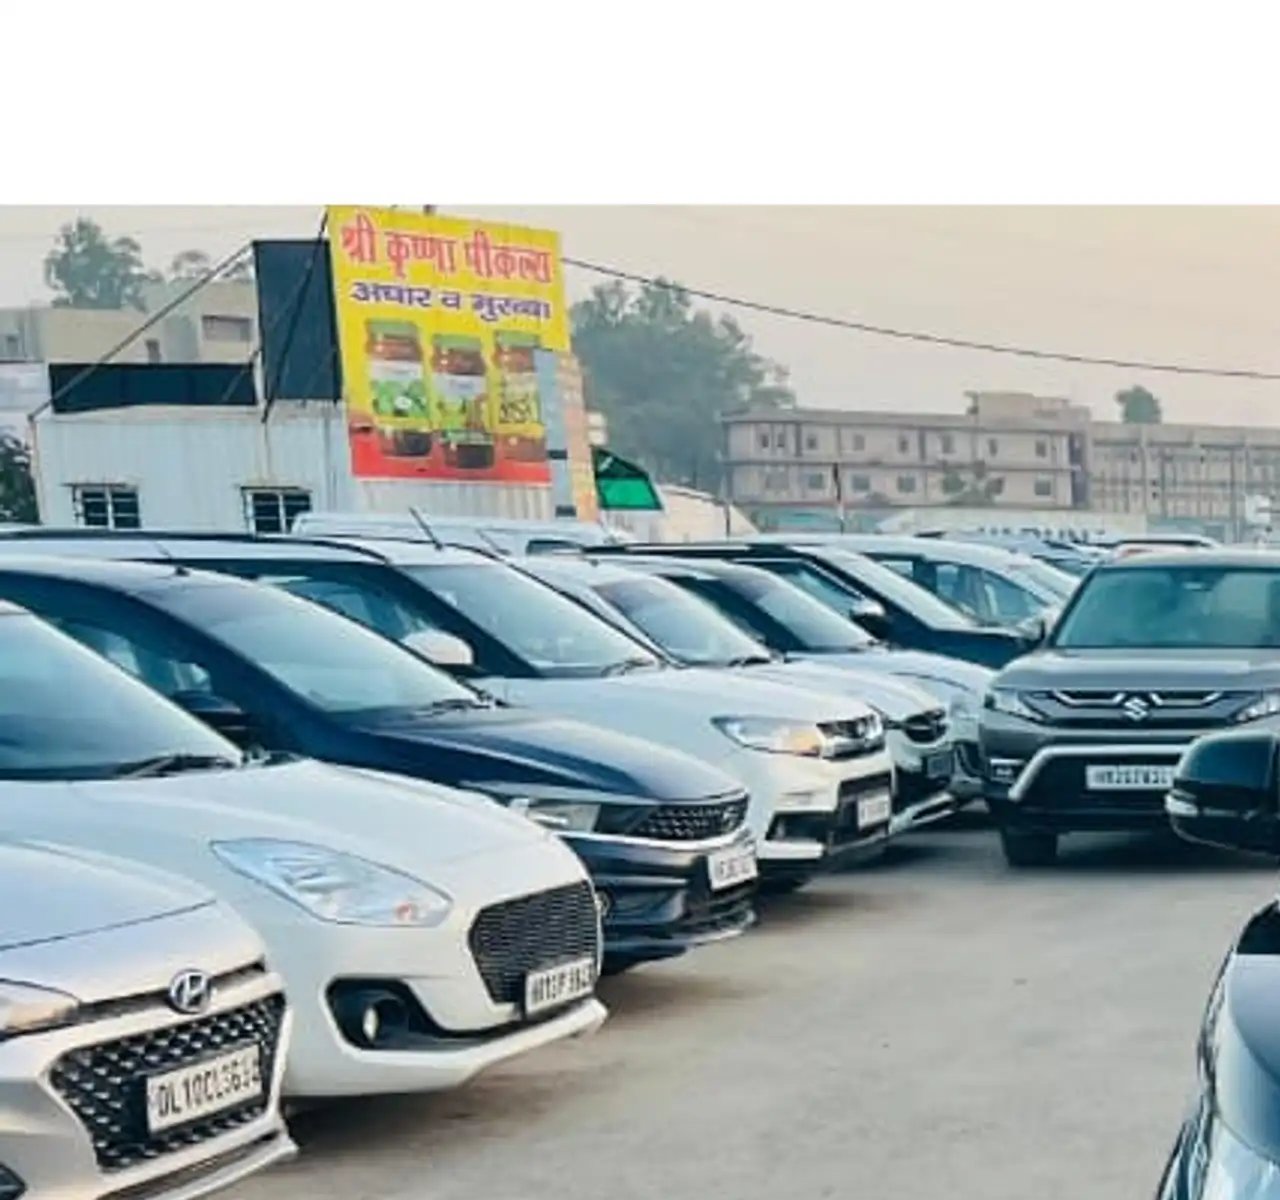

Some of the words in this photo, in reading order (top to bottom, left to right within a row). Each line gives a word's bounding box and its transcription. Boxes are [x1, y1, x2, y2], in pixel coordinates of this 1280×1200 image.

[341, 212, 377, 263] श्री
[385, 231, 457, 278] कृष्णा
[350, 282, 432, 308] अचार
